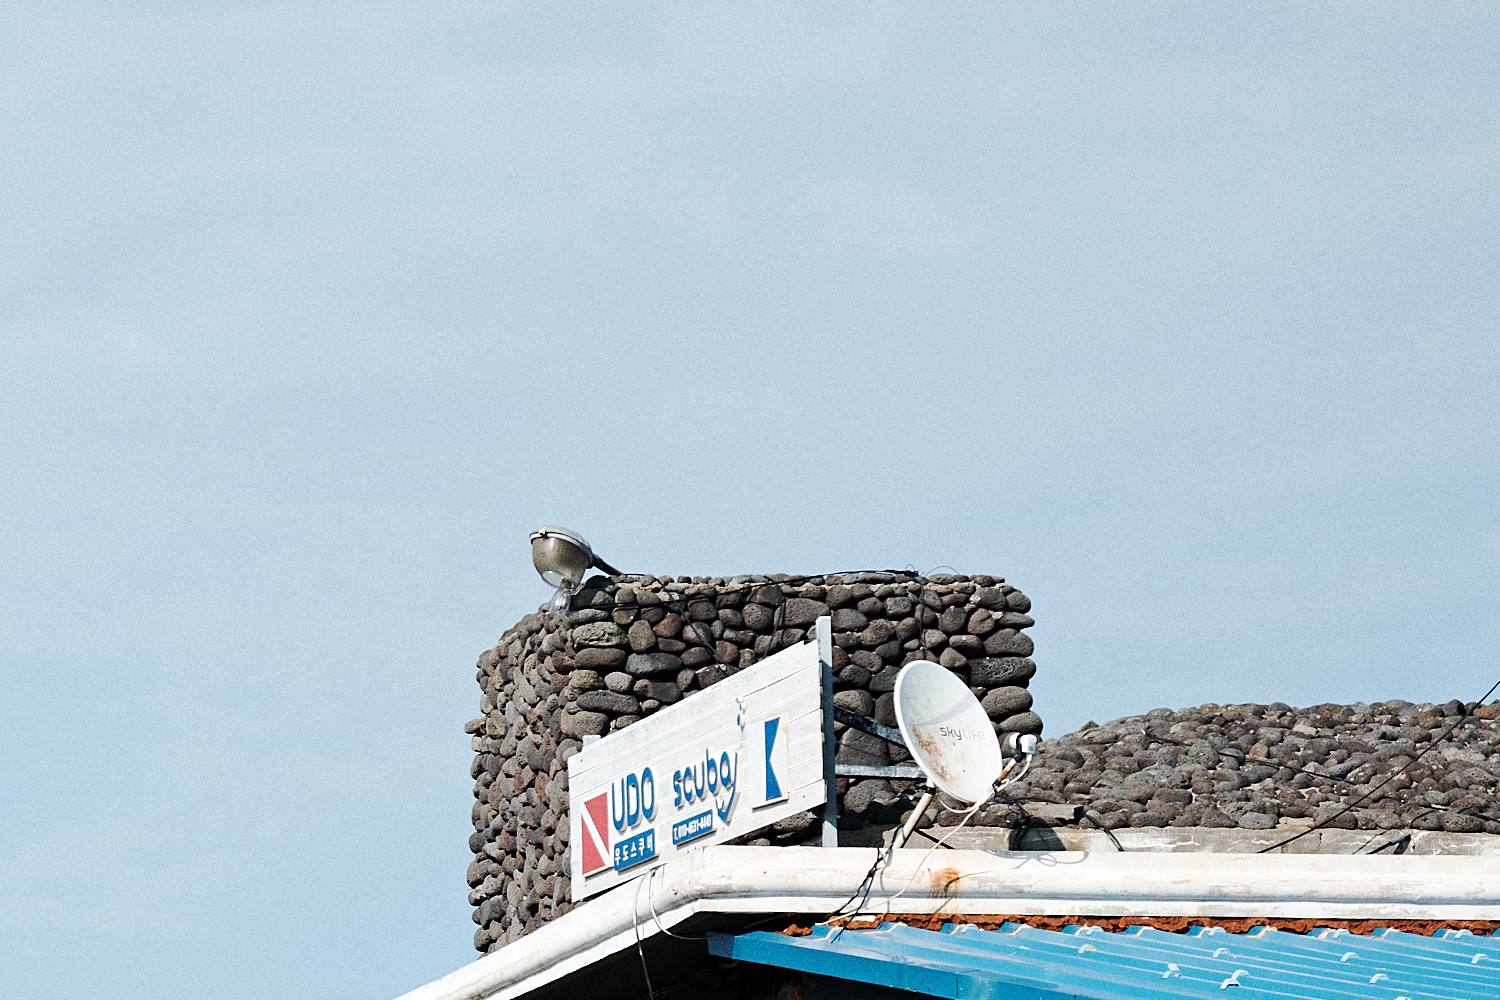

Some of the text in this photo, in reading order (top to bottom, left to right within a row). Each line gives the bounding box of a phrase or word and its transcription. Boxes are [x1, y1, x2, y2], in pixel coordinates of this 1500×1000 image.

[939, 726, 986, 741] skylife
[612, 766, 655, 832] UDO
[614, 833, 654, 866] 우도스쿠버
